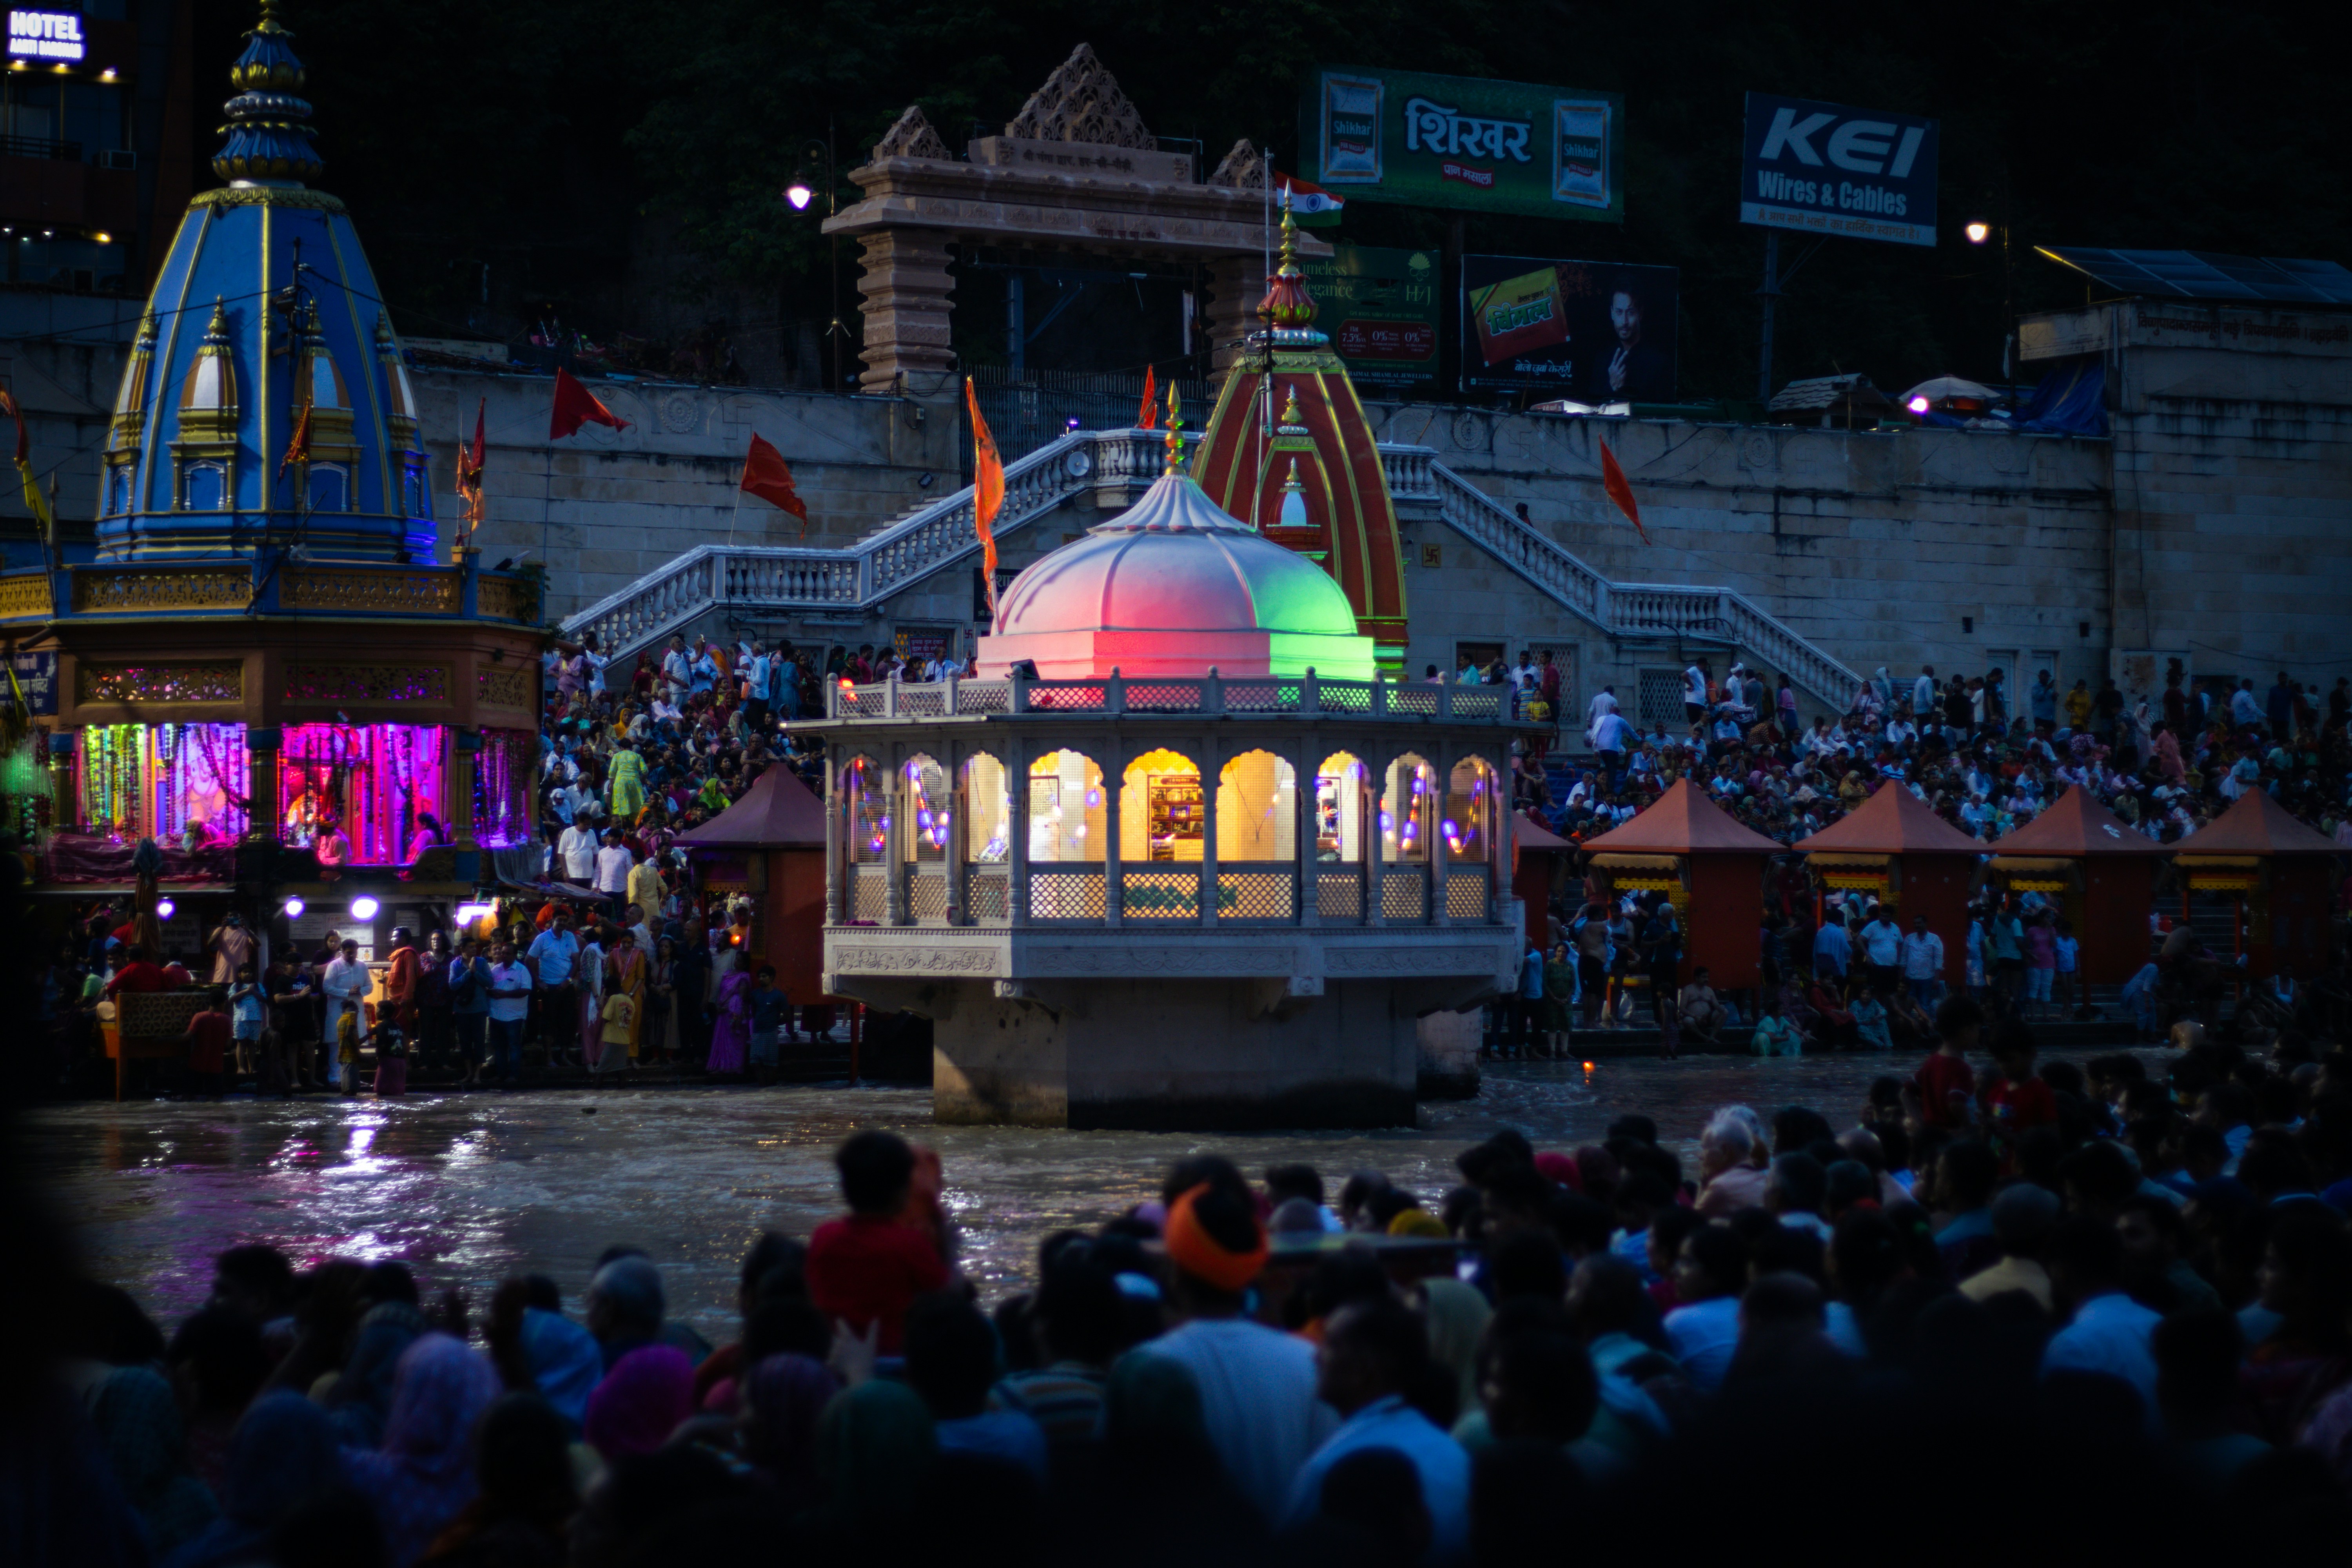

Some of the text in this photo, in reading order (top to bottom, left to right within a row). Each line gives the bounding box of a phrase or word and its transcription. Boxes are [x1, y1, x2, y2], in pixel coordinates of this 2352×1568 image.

[11, 11, 81, 41] HOTEL
[1334, 120, 1372, 135] Shikhar
[1405, 98, 1532, 162] शिखर
[1564, 143, 1599, 158] Shikhar
[1759, 107, 1926, 178] KEI
[1443, 164, 1492, 185] पान मसाला
[1758, 170, 1907, 216] Wires & Cables
[1302, 261, 1347, 276] imeless
[1303, 277, 1356, 300] legance
[1486, 295, 1553, 336] विमल
